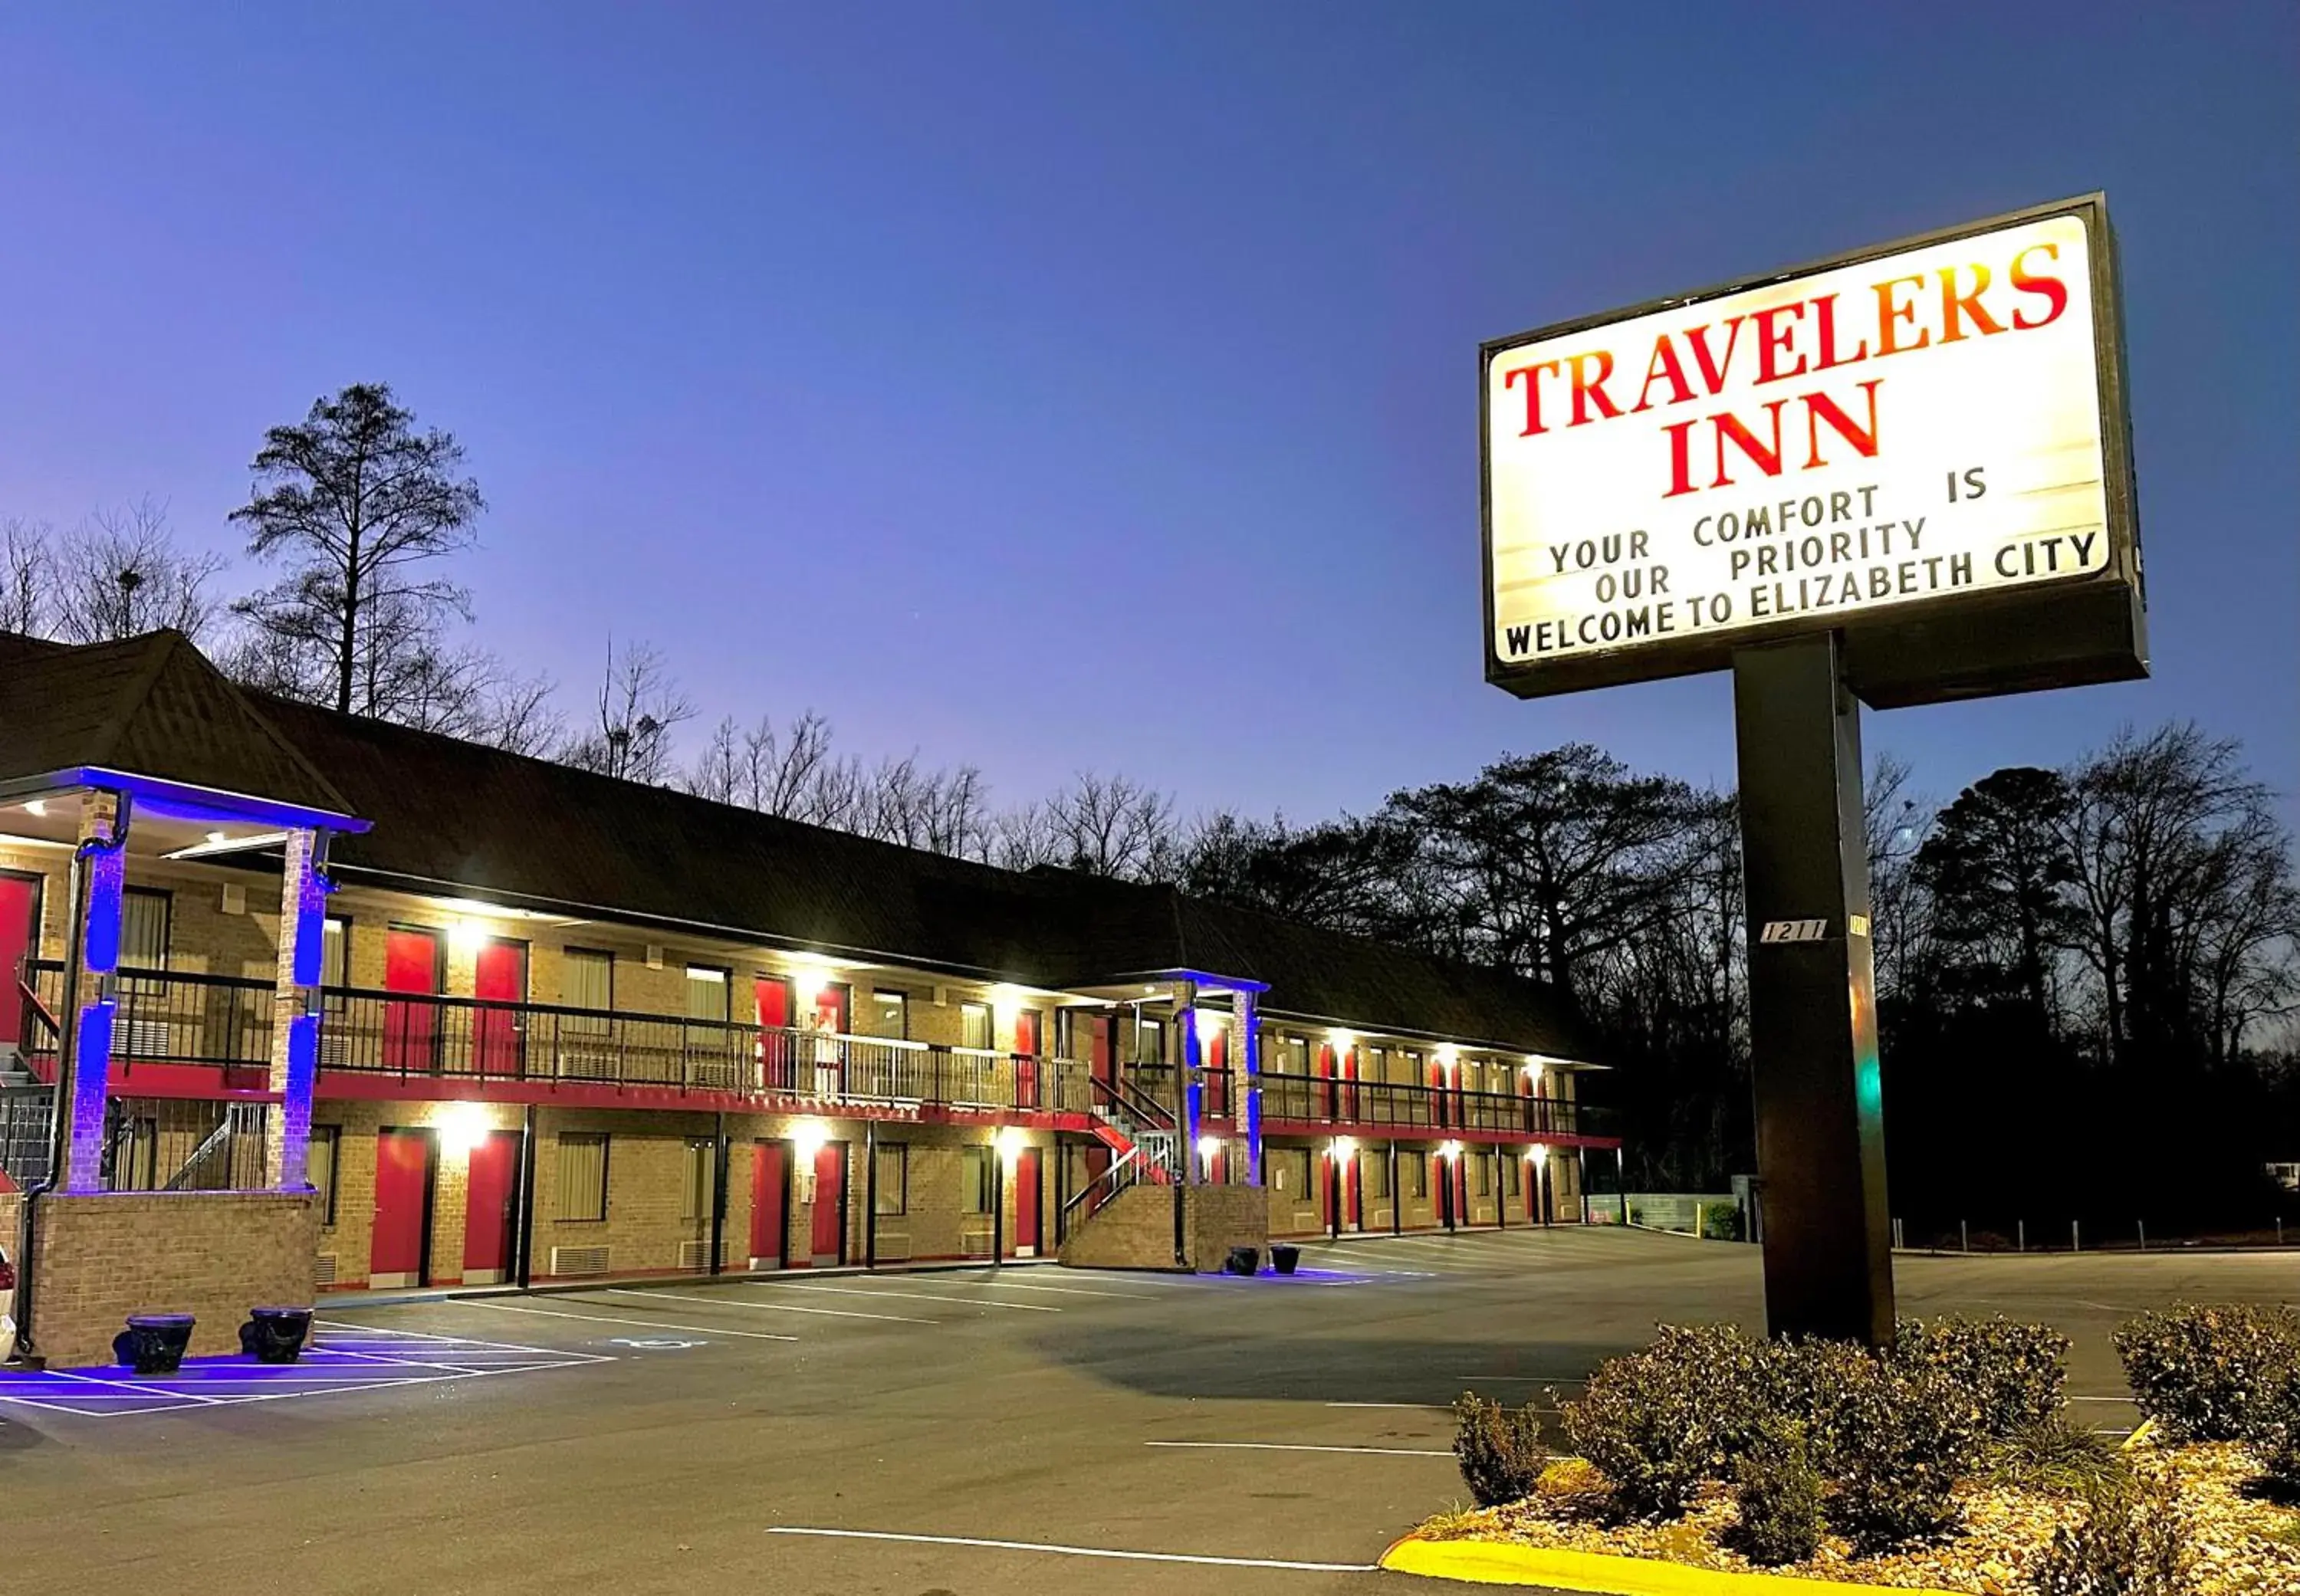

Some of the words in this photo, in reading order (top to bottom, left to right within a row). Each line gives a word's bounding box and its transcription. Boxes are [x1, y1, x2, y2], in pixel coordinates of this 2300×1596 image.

[1505, 242, 2070, 438] TRAVELERS
[1660, 379, 1885, 499] INN
[1549, 529, 1650, 573] YOUR
[1693, 484, 1880, 547] COMFORT
[1947, 467, 1987, 504] IS
[1595, 564, 1670, 604] OUR
[1730, 517, 1927, 581] PRIORITY
[1506, 601, 1674, 656] WELCOME
[1685, 593, 1733, 627] TO
[1750, 550, 1973, 616] ELIZABETH
[1994, 531, 2097, 578] CITY
[1766, 921, 1821, 941] 1211
